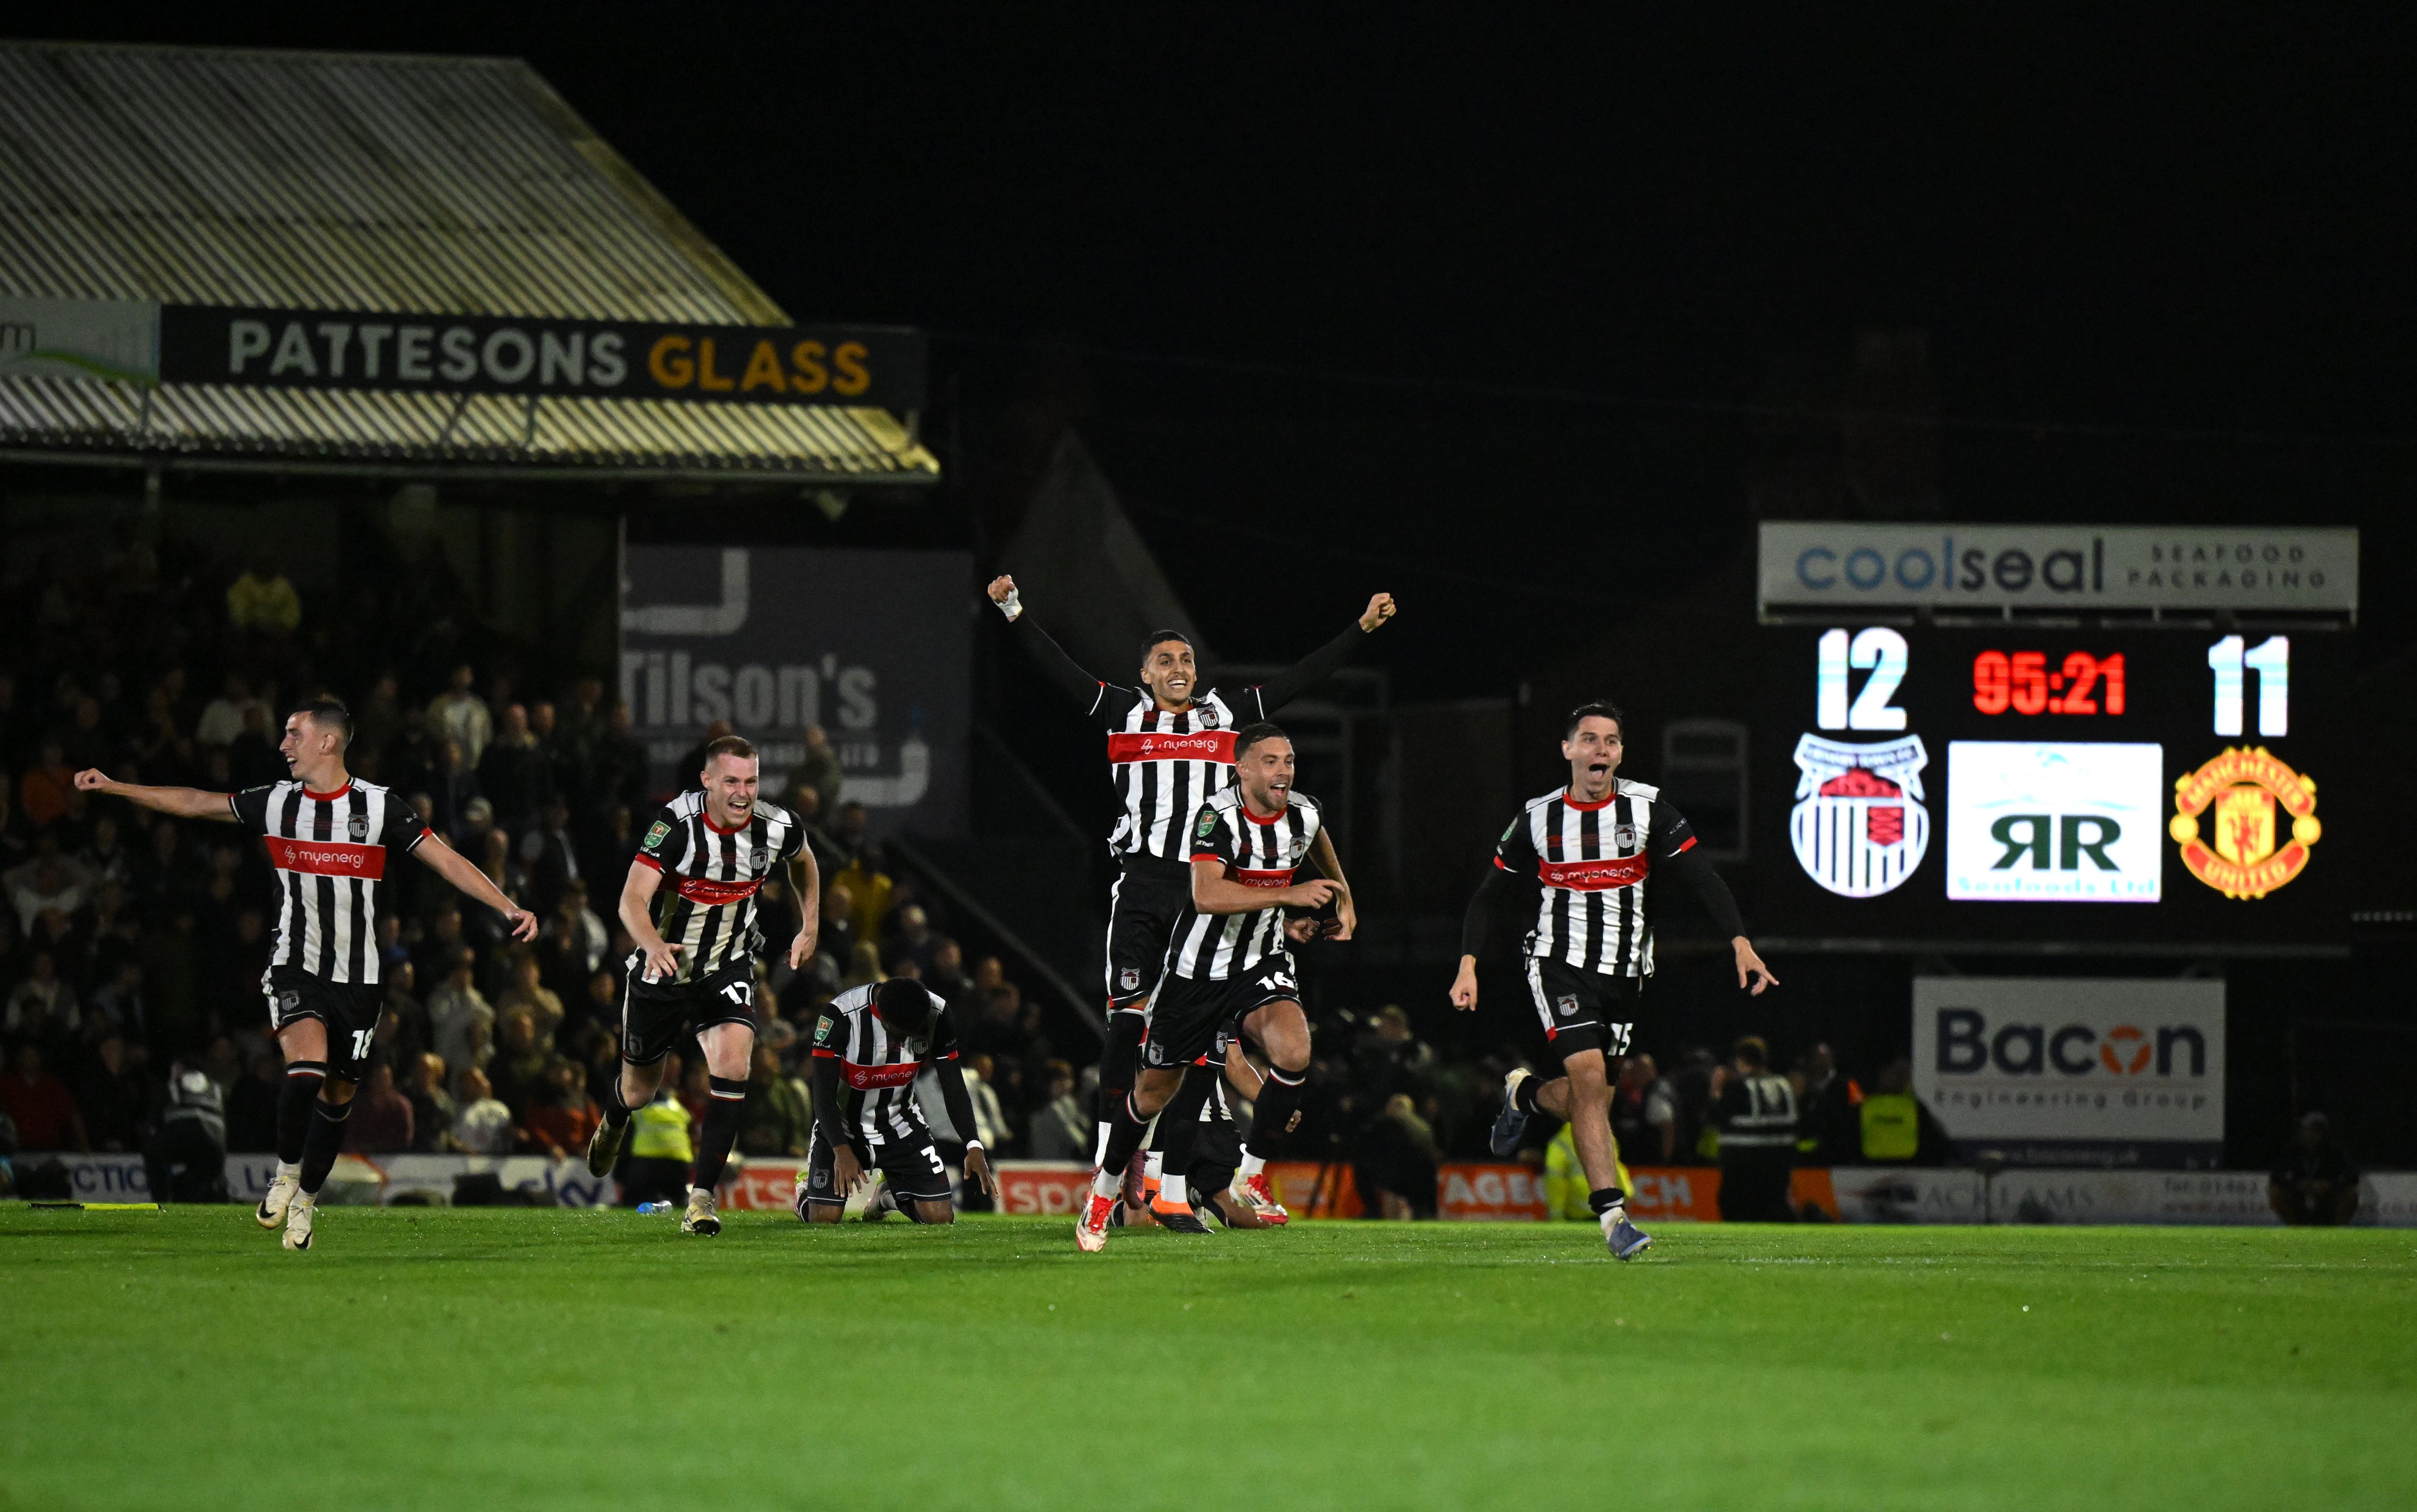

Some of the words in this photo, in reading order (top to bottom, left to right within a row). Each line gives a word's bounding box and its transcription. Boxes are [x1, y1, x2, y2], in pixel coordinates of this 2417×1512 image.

[228, 318, 628, 387] PATTESONS
[648, 335, 872, 395] GLASS
[1796, 536, 2104, 593] coolseal
[2152, 542, 2305, 565] SEAFOOD
[2127, 569, 2327, 590] PACKAGING
[1817, 627, 1908, 730] 12
[1973, 650, 2126, 716] 95:21
[2208, 635, 2289, 737] 11
[299, 850, 364, 868] myenergi
[1567, 866, 1634, 883] myenergi
[720, 981, 751, 1007] 17
[1255, 971, 1294, 990] 16
[351, 1027, 374, 1061] 18
[1936, 1006, 2206, 1076] Bacon
[2122, 1090, 2205, 1111] Group
[920, 1145, 944, 1175] 3
